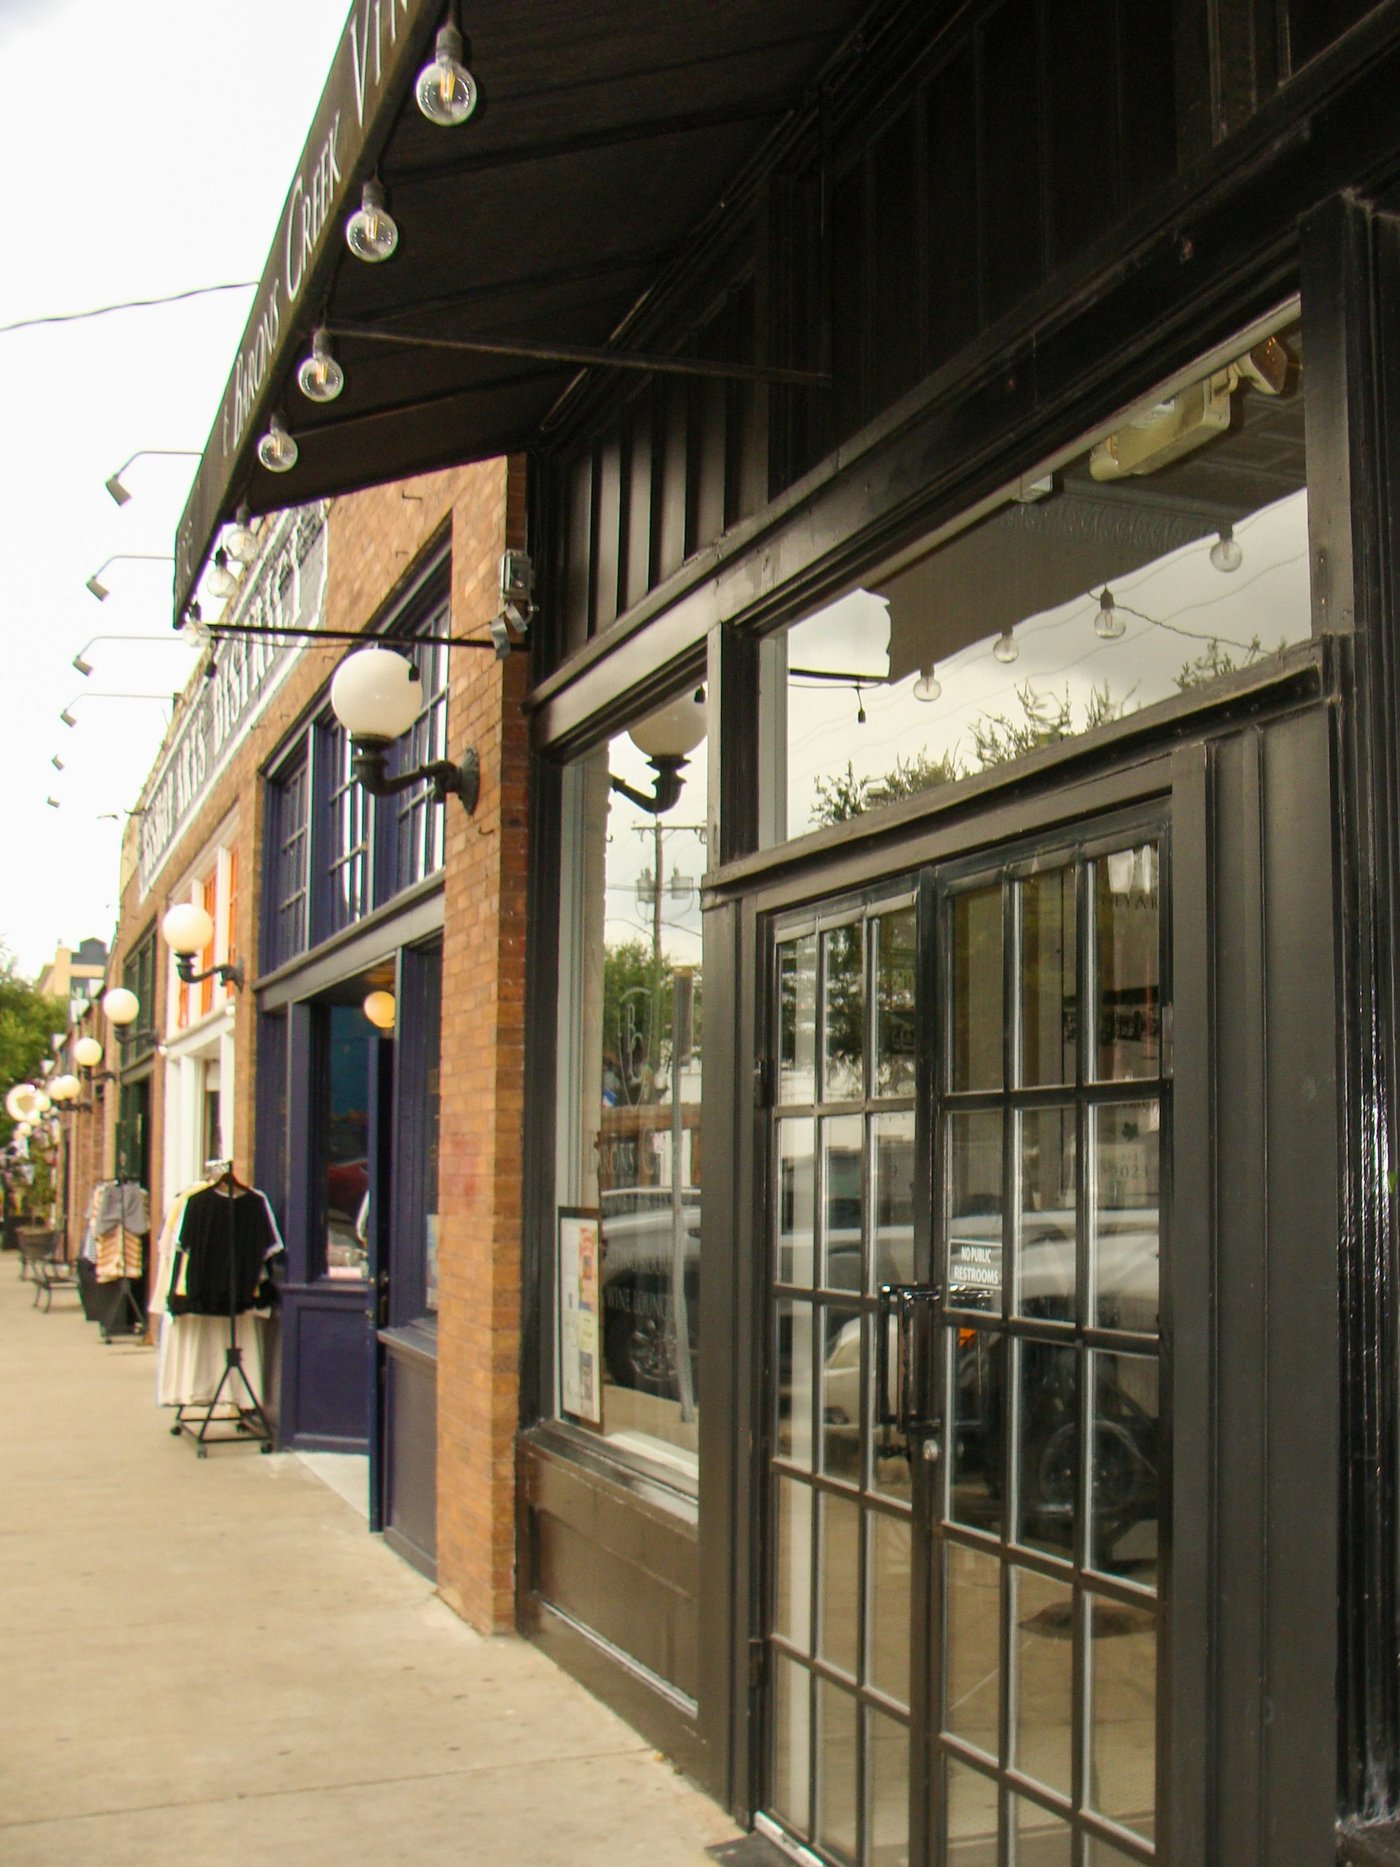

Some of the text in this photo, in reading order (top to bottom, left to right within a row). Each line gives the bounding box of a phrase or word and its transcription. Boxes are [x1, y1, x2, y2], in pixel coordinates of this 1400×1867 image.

[285, 109, 342, 303] CREEK
[961, 1246, 991, 1263] NO PUBLIC
[954, 1266, 999, 1284] RESTROOMS
